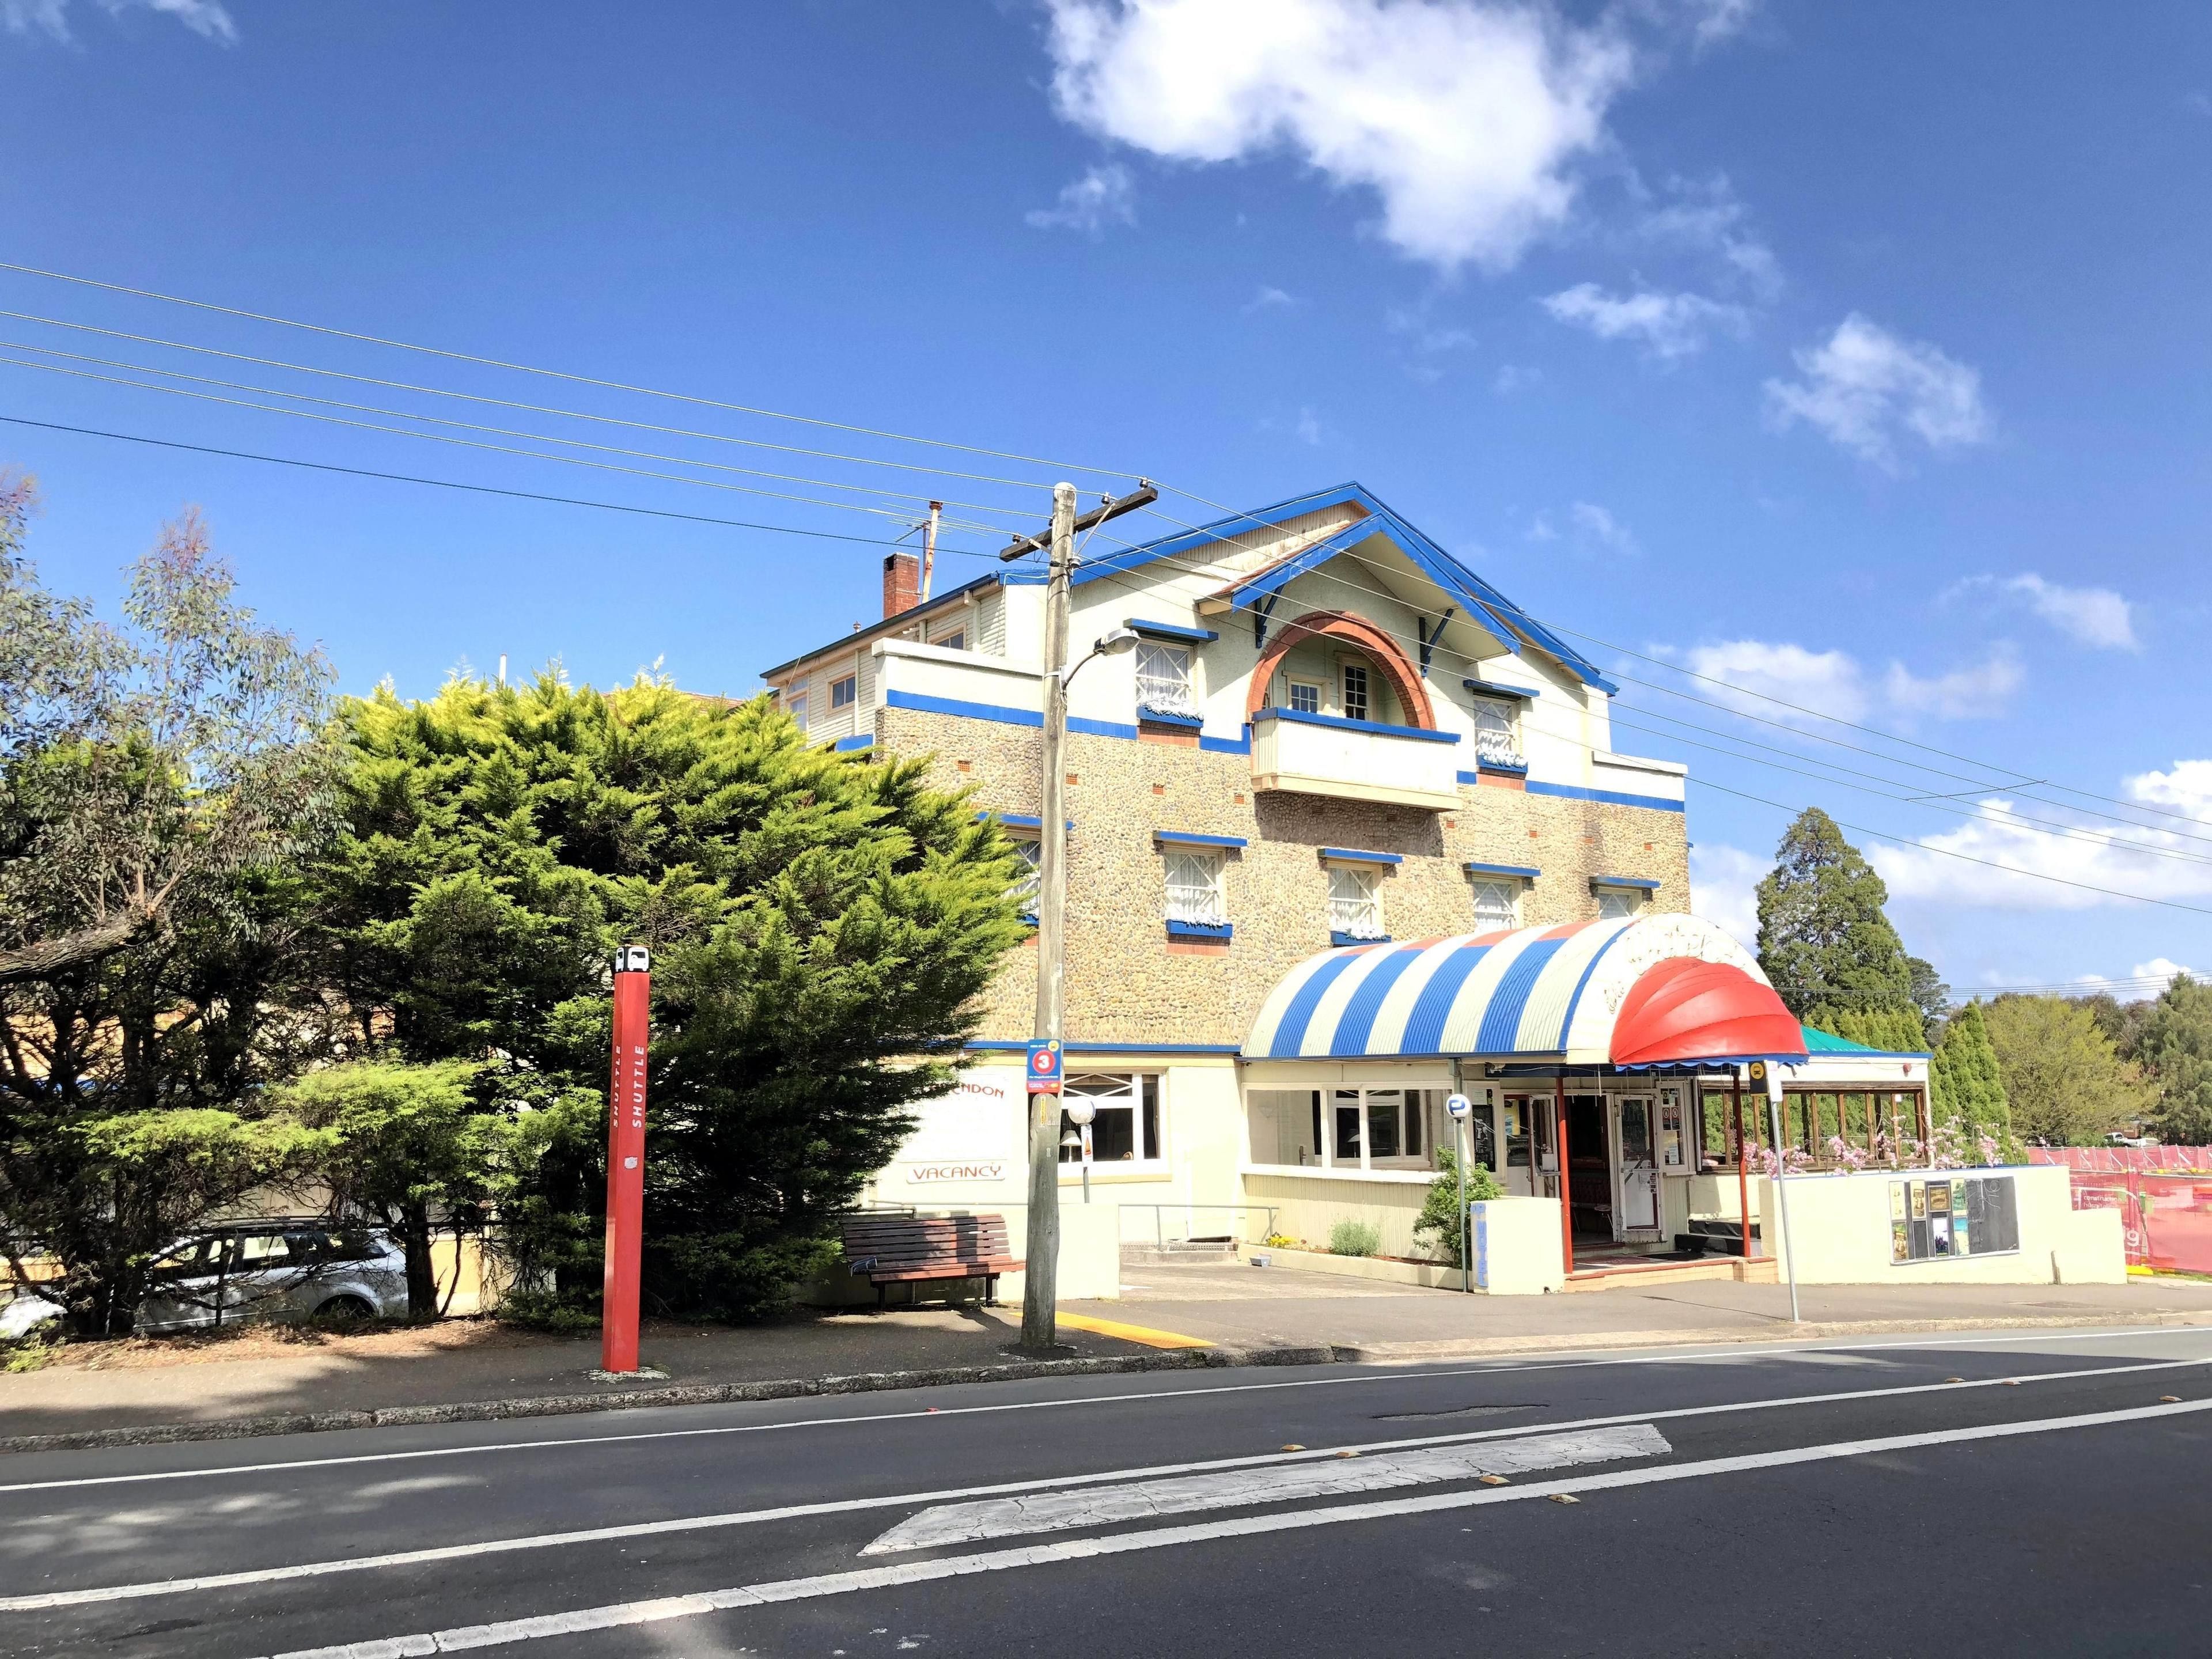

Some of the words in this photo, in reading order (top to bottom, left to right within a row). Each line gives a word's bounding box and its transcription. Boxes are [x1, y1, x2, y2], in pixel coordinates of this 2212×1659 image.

[1038, 1055, 1050, 1069] 3
[632, 1046, 644, 1128] SHUTTLE
[913, 1165, 1001, 1180] VACANCY
